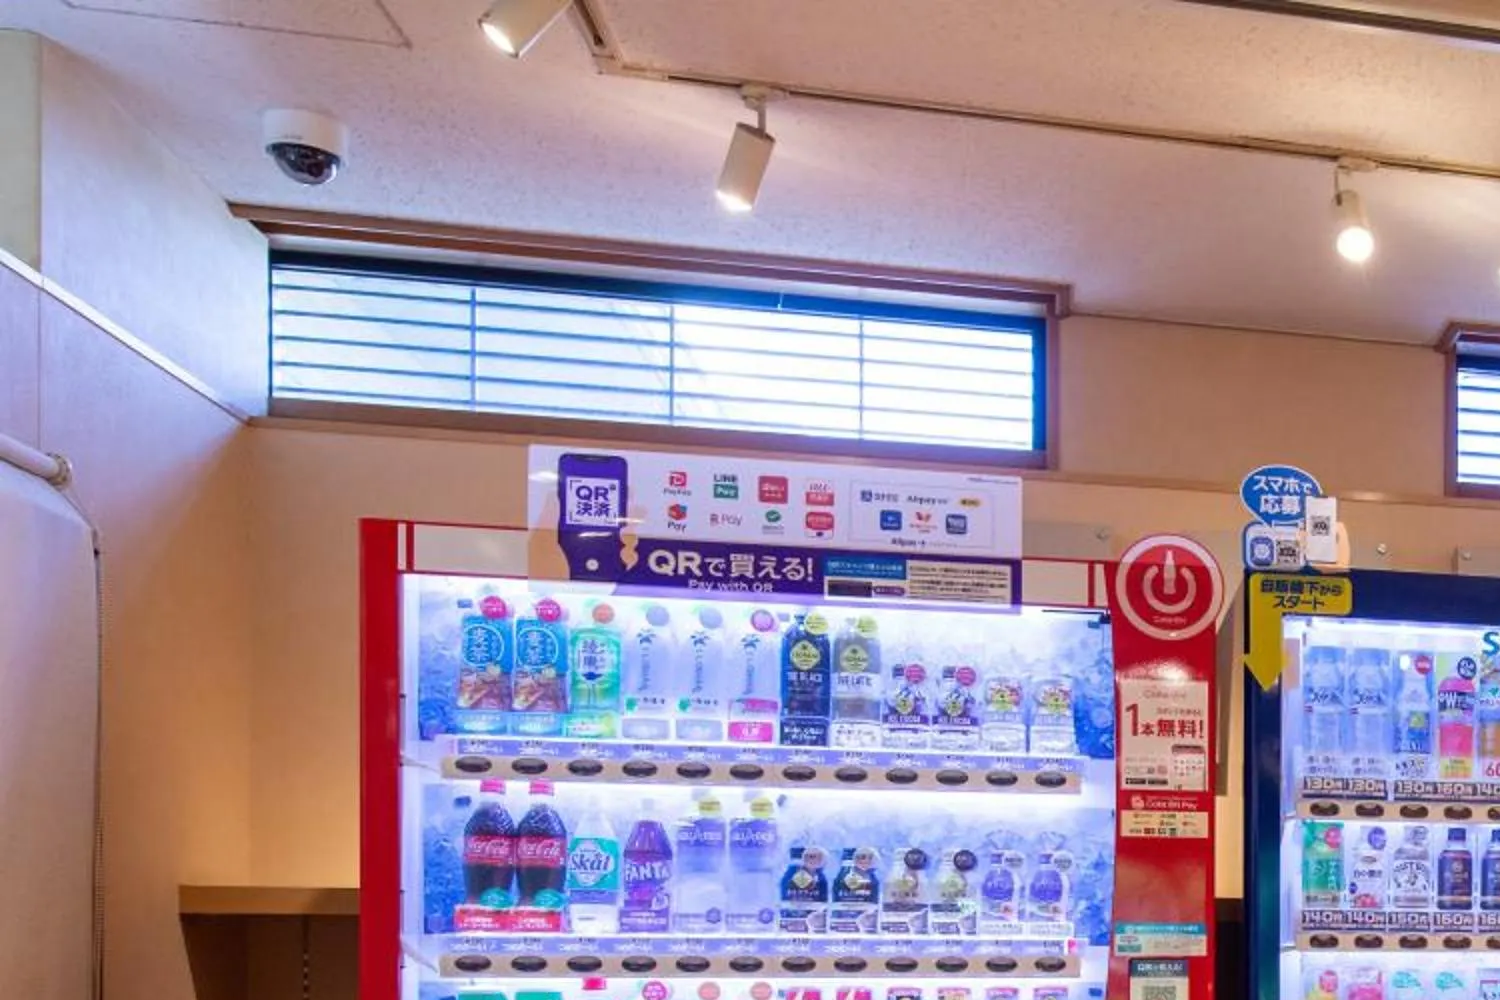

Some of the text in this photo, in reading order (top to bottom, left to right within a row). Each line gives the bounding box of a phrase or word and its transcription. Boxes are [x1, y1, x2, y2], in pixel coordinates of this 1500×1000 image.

[575, 485, 609, 501] QR
[1252, 476, 1313, 494] スマホで
[576, 502, 611, 517] 決済
[1260, 495, 1301, 515] 応募
[649, 549, 814, 581] QRで買える!
[1273, 597, 1325, 611] スタート
[1124, 703, 1204, 739] 1本無料!
